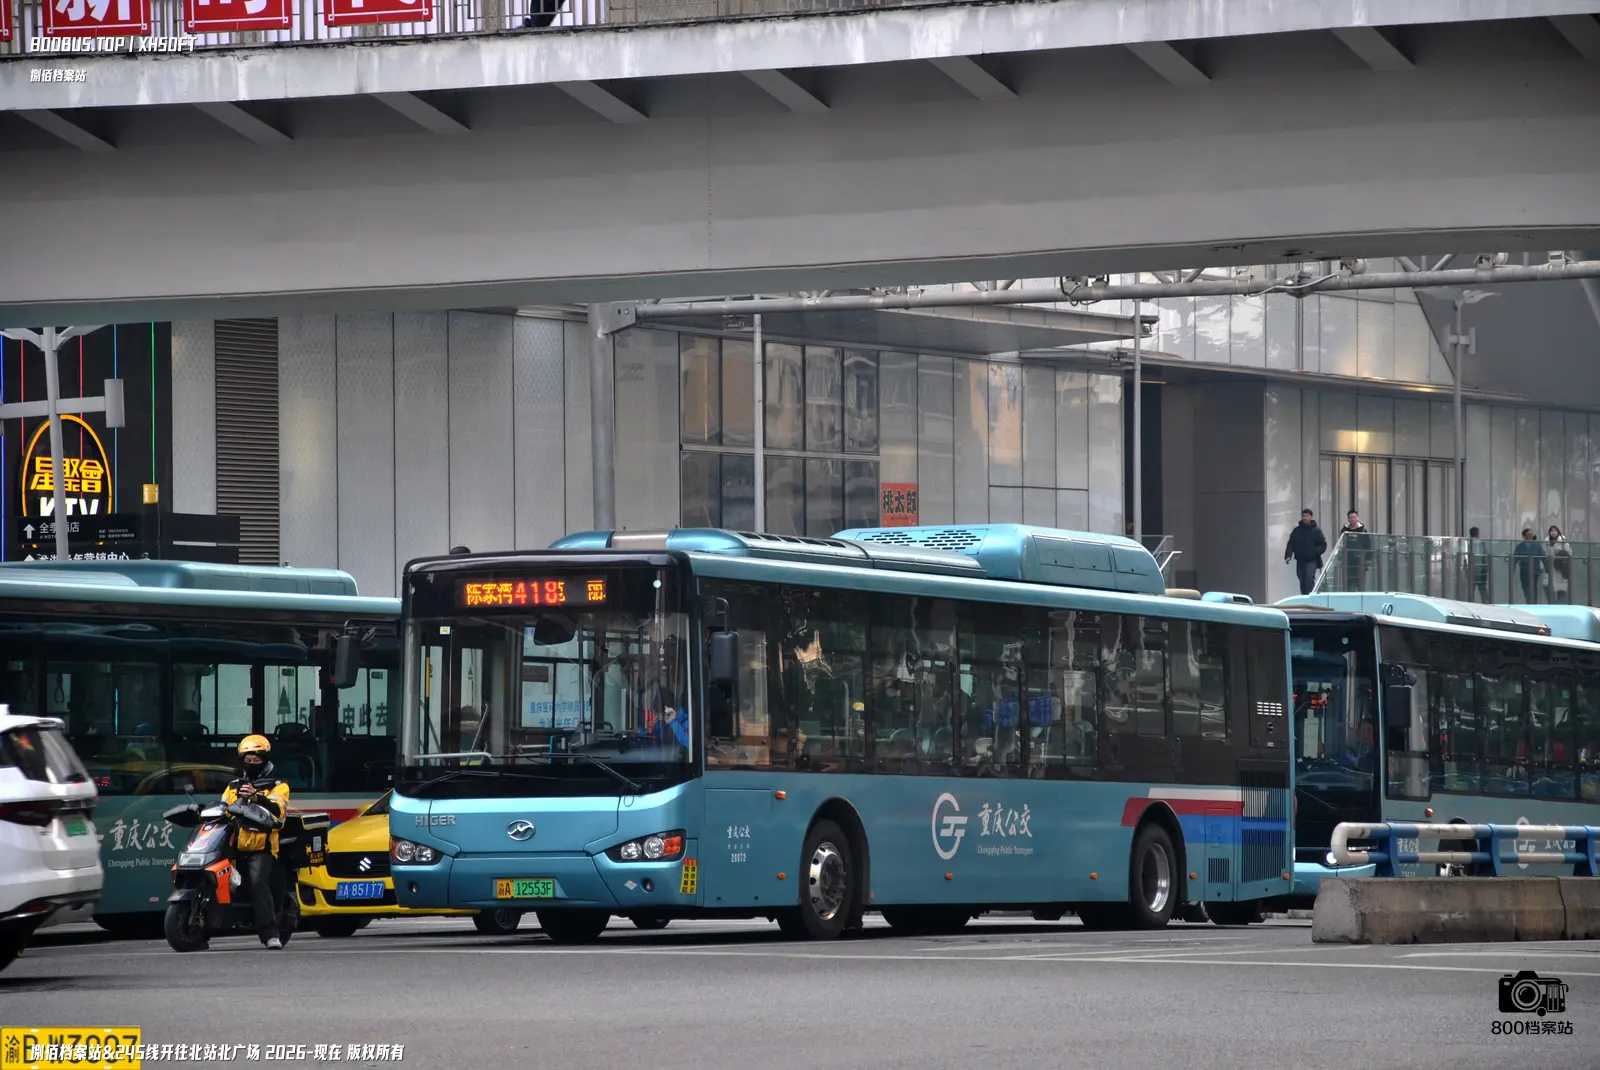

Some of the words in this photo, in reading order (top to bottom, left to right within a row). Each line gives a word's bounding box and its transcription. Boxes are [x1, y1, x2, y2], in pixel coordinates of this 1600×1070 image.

[415, 815, 456, 826] HIGER
[977, 802, 1033, 838] 重庆公交
